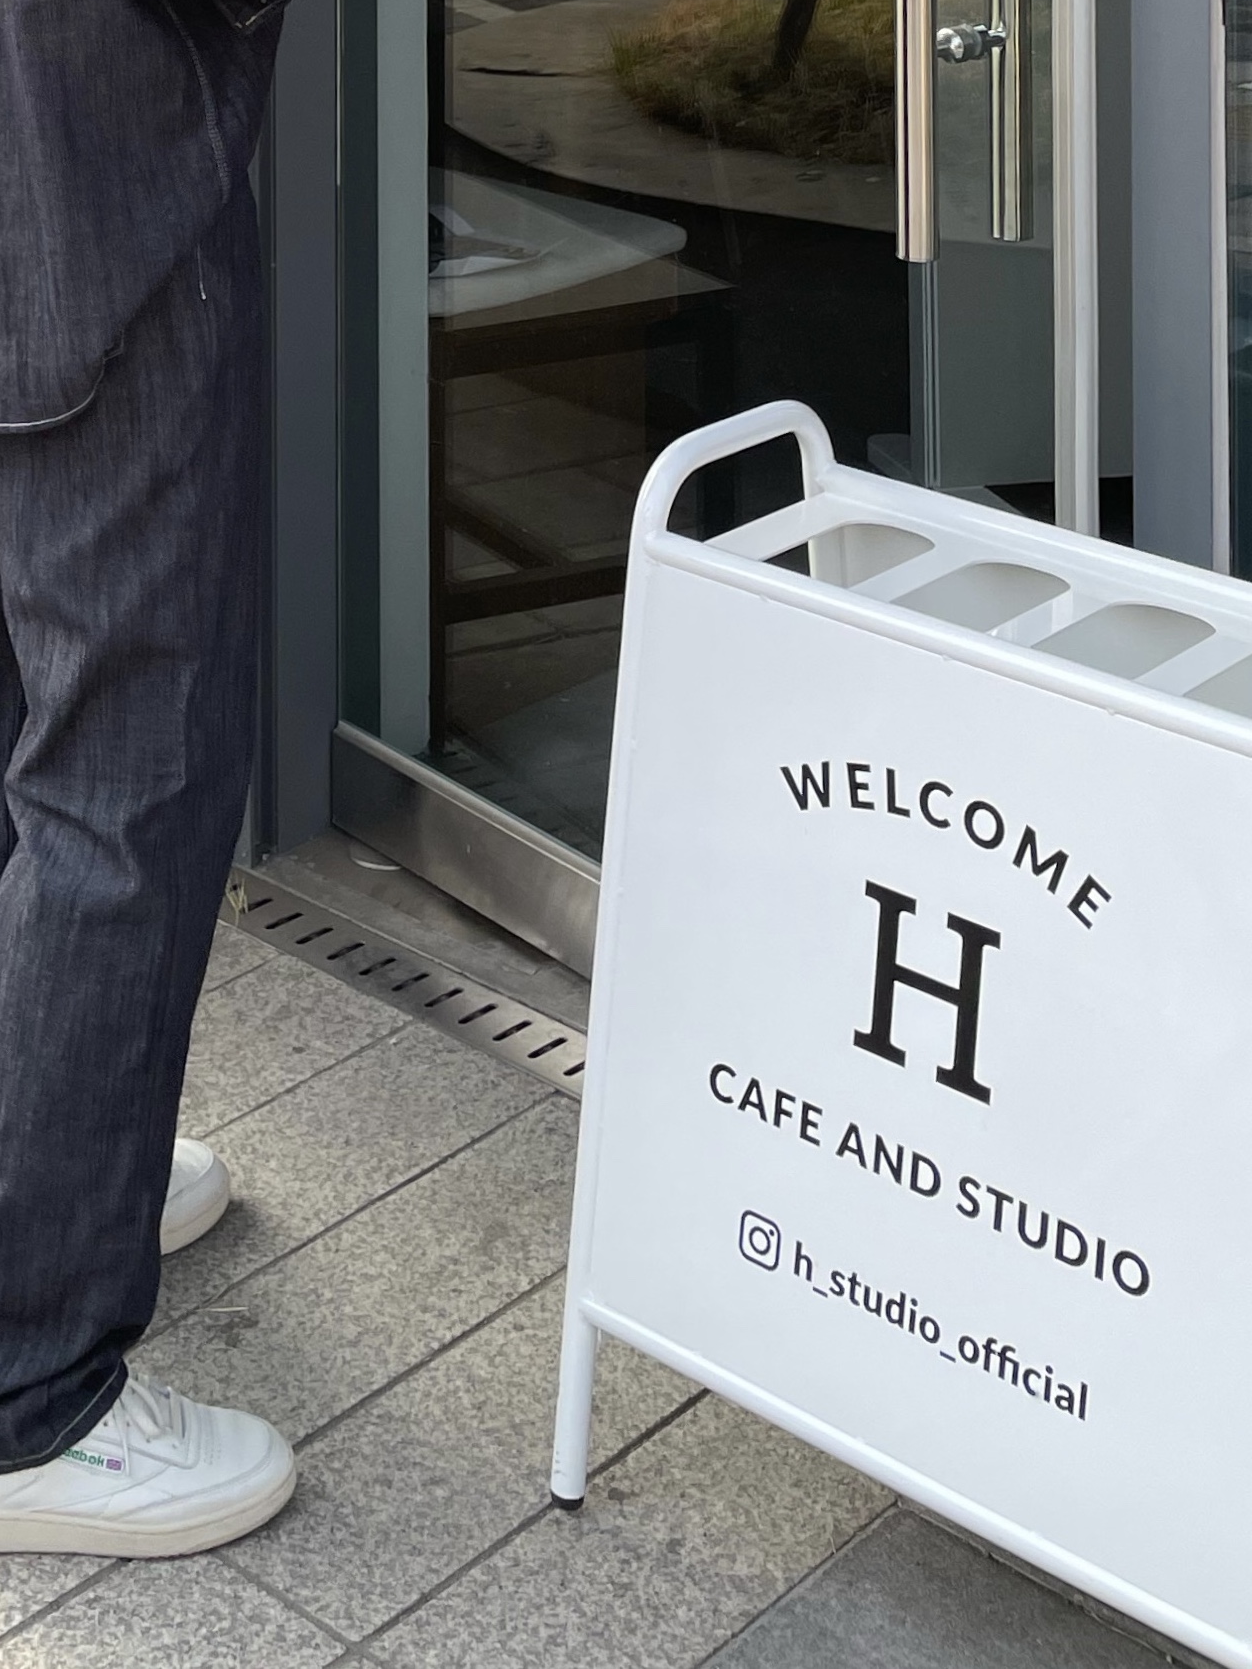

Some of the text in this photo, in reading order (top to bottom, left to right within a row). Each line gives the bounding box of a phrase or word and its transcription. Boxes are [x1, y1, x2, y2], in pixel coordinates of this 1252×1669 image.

[779, 760, 1112, 930] WELCOME
[853, 879, 1001, 1106] H
[708, 1062, 1151, 1298] CAFE AND STUDIO
[793, 1239, 1089, 1423] h_studio_official
[63, 1448, 104, 1467] eebok
